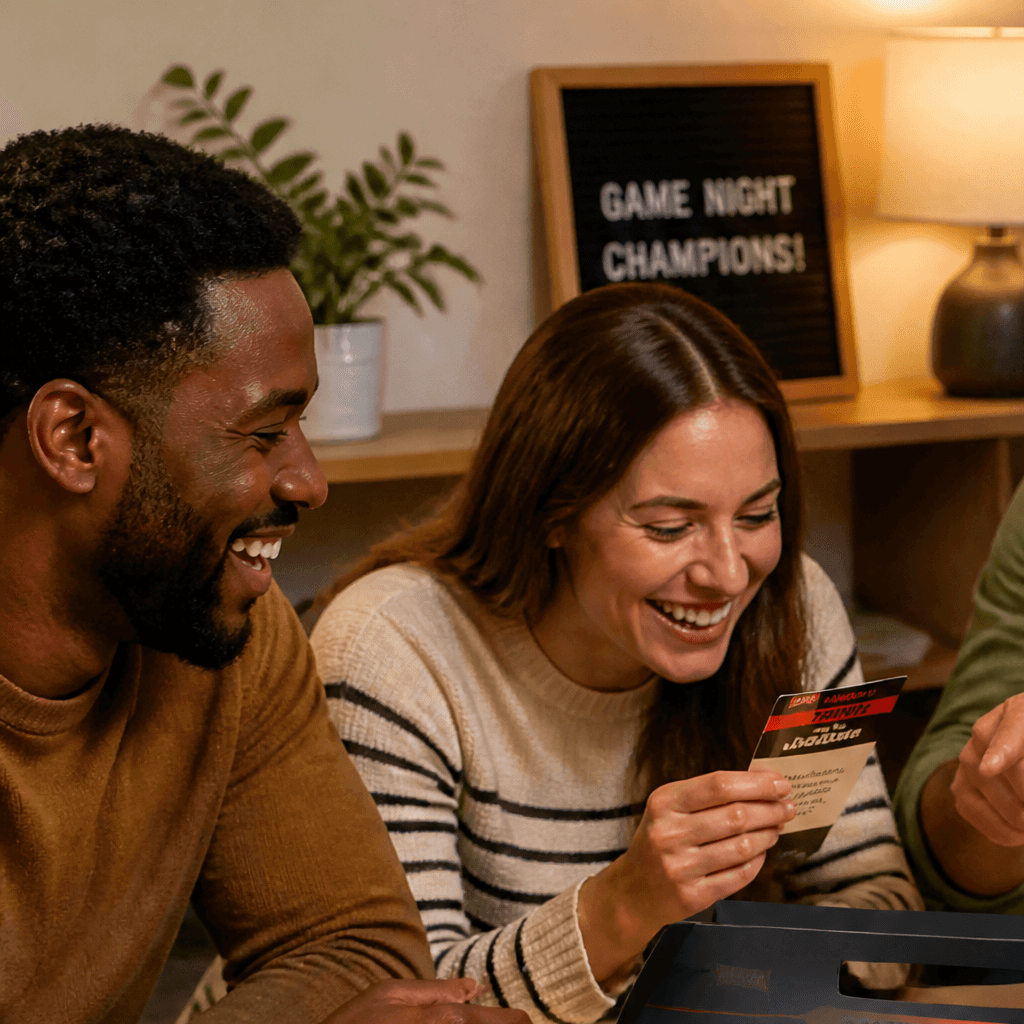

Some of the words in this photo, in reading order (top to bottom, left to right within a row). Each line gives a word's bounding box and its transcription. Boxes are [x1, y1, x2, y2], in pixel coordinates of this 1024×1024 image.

[600, 180, 693, 222] GAME
[703, 175, 796, 217] NIGHT
[602, 232, 806, 282] CHAMPIONS!
